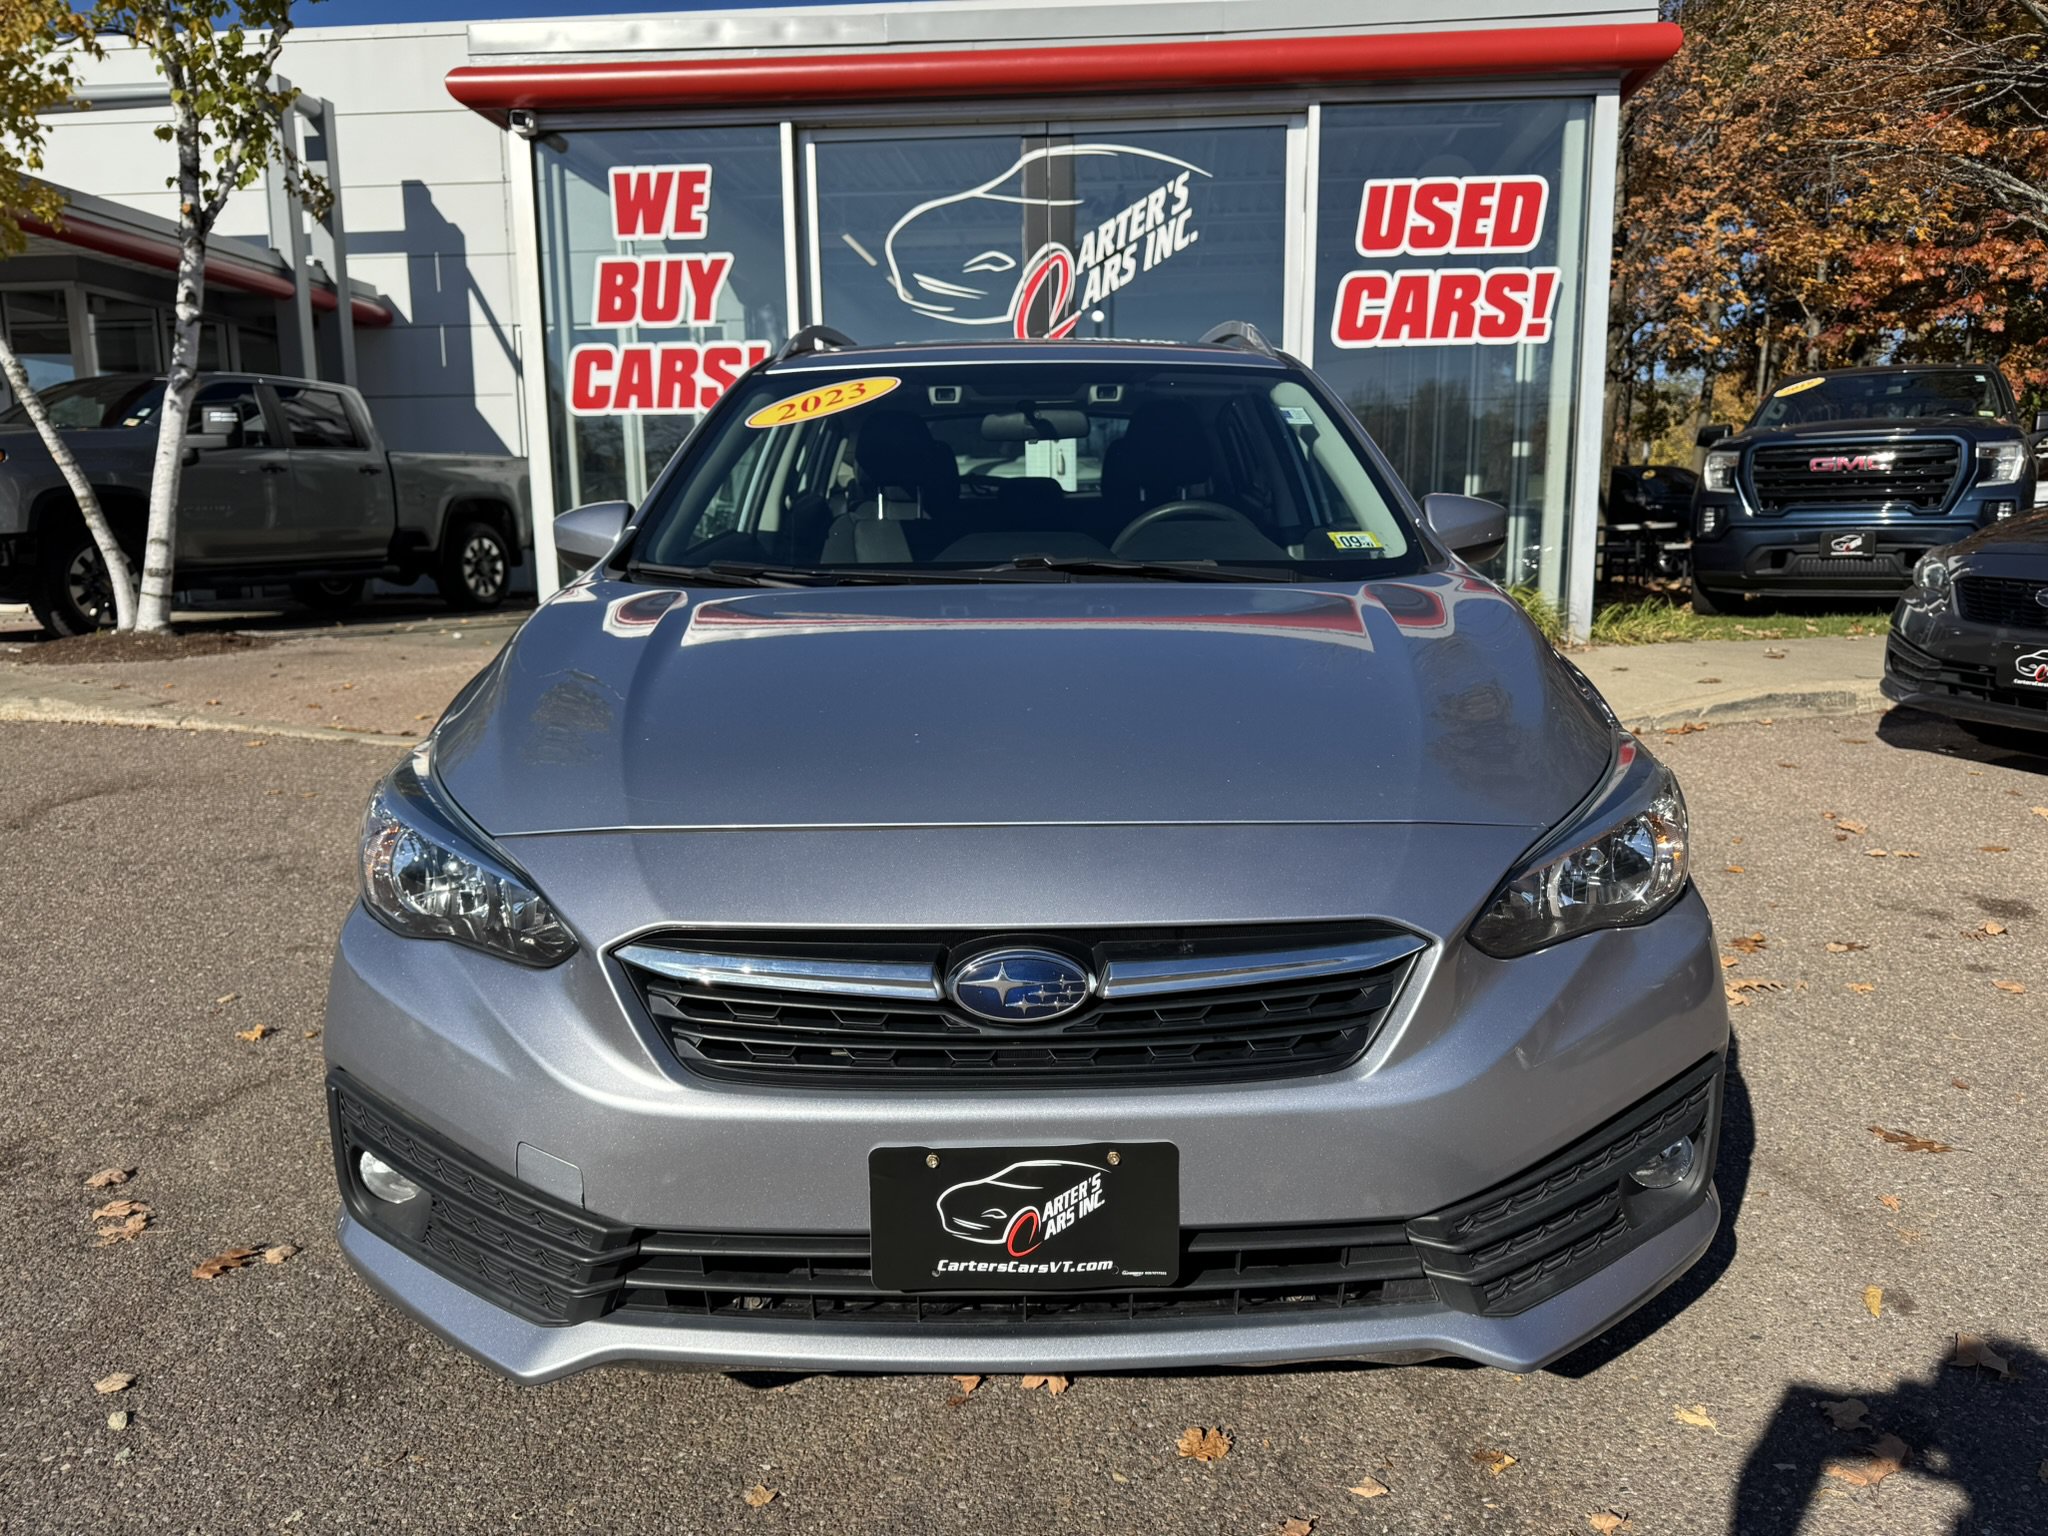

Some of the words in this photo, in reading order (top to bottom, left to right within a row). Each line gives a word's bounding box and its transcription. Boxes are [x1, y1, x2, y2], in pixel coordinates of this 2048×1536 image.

[611, 167, 709, 238] WE
[1359, 178, 1545, 253] USED
[1143, 208, 1199, 272] INC.
[595, 255, 730, 326] BUY
[1334, 270, 1557, 344] CARS!
[777, 386, 867, 422] 2023
[1809, 453, 1894, 473] GMC
[1339, 535, 1362, 549] 09
[937, 1259, 1113, 1274] CartersCarsVT.com
